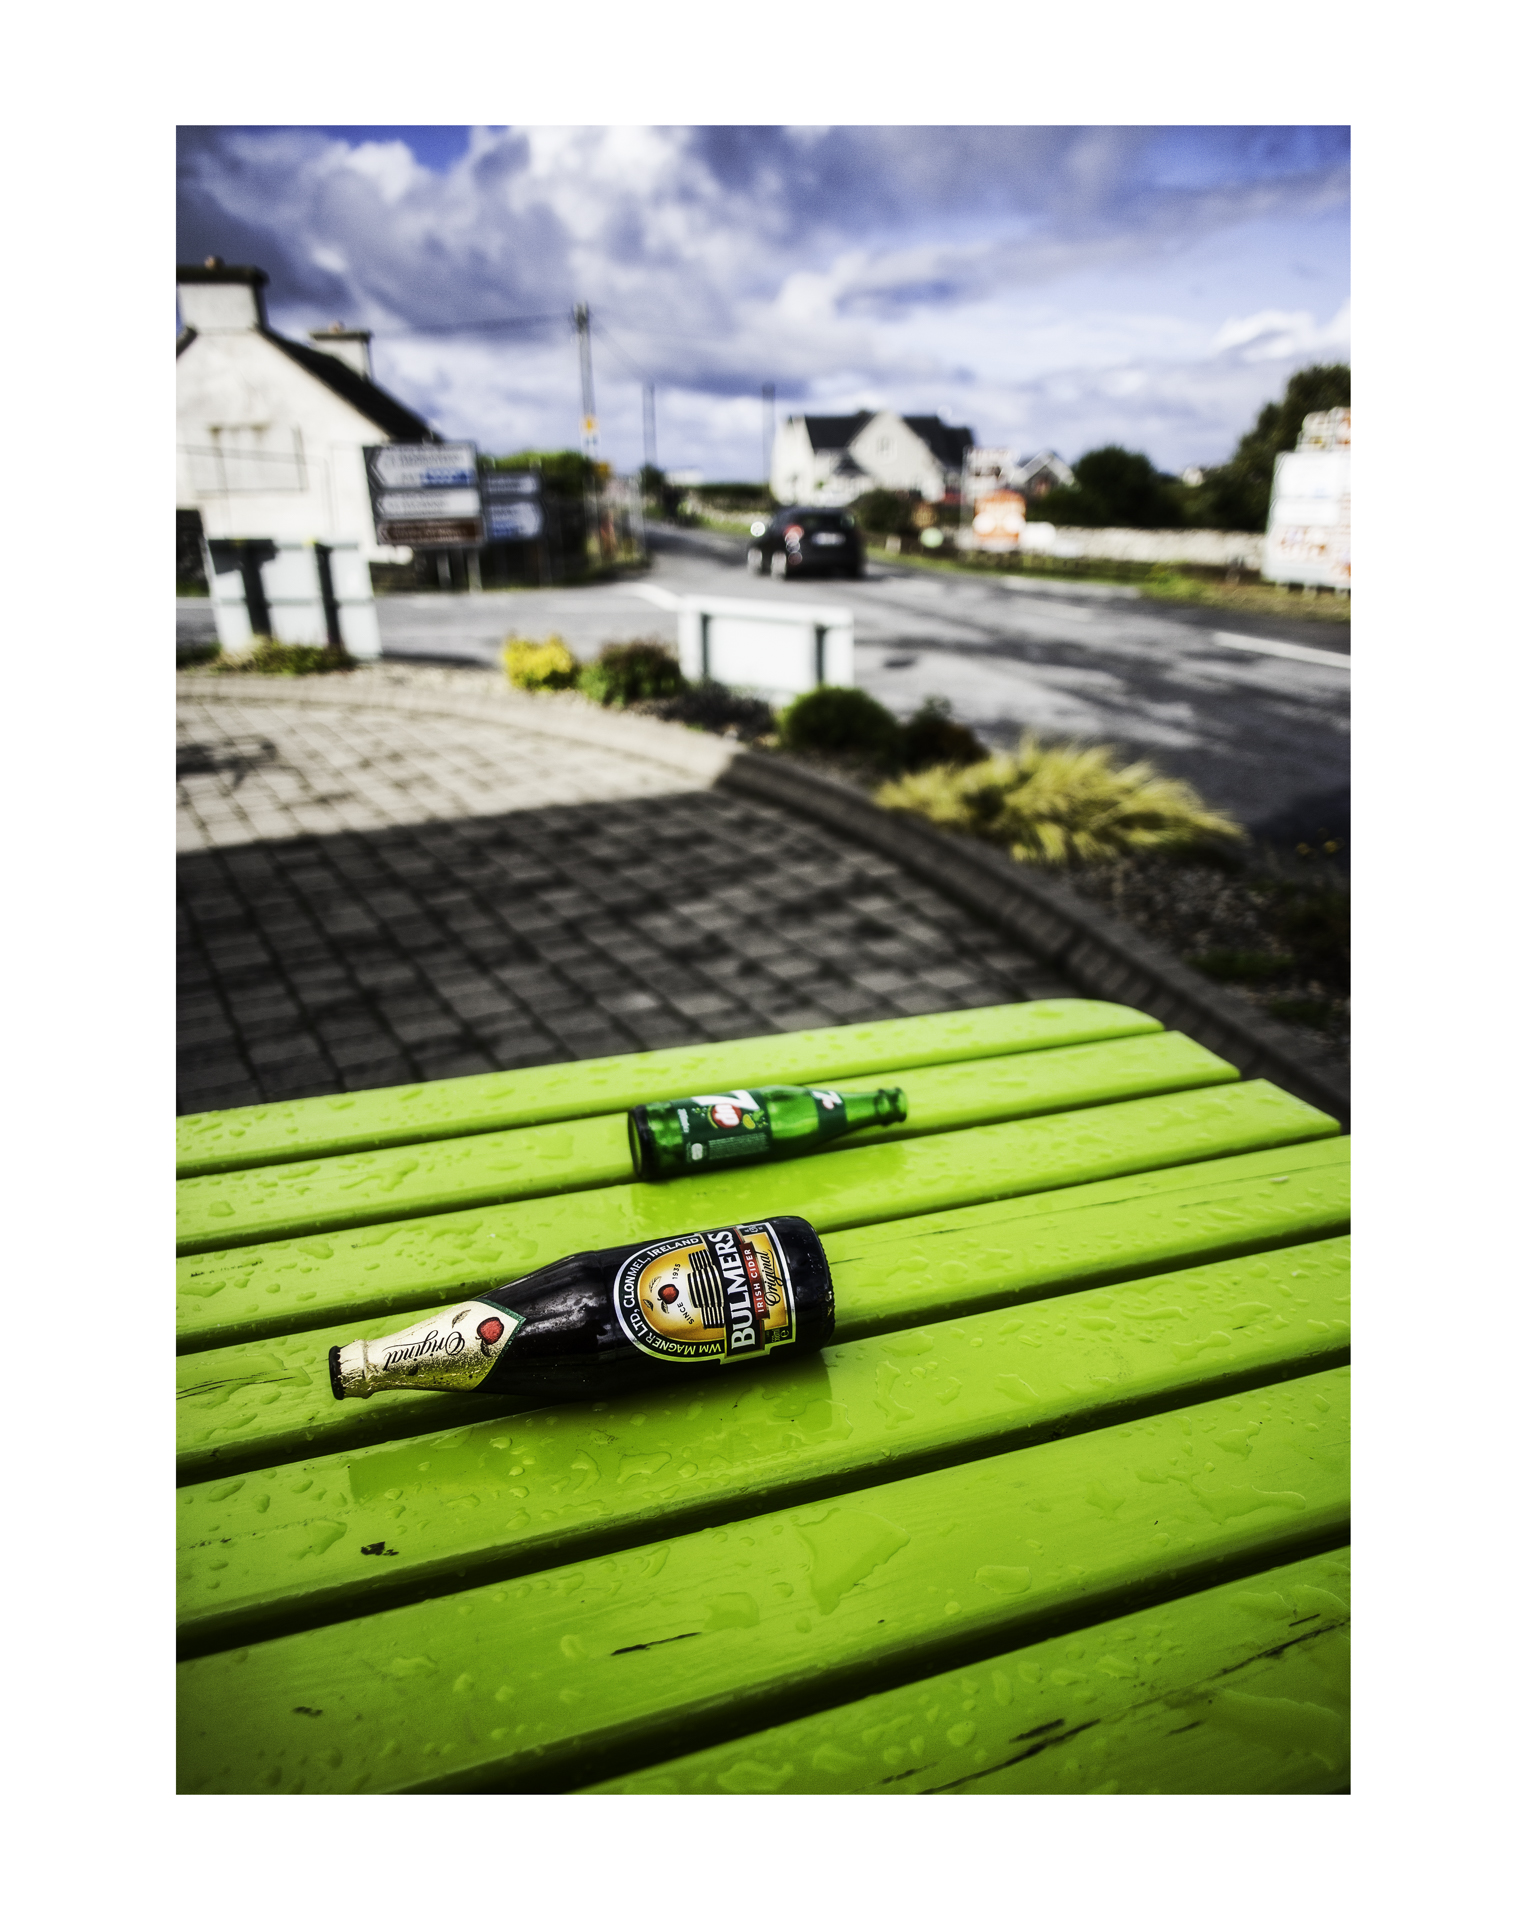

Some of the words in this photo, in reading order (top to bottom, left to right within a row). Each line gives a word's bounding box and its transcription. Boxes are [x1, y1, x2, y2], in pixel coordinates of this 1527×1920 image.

[647, 1237, 699, 1258] IRELAND
[672, 1263, 681, 1280] 1935
[744, 1249, 758, 1279] CIDER
[755, 1249, 783, 1307] Original
[623, 1258, 651, 1308] CLONMEL,
[707, 1230, 756, 1350] BULMERS
[753, 1282, 765, 1313] IRISH
[677, 1302, 695, 1325] SINCE
[382, 1330, 465, 1371] Original
[645, 1332, 696, 1355] MAGNER
[699, 1343, 721, 1355] WM
